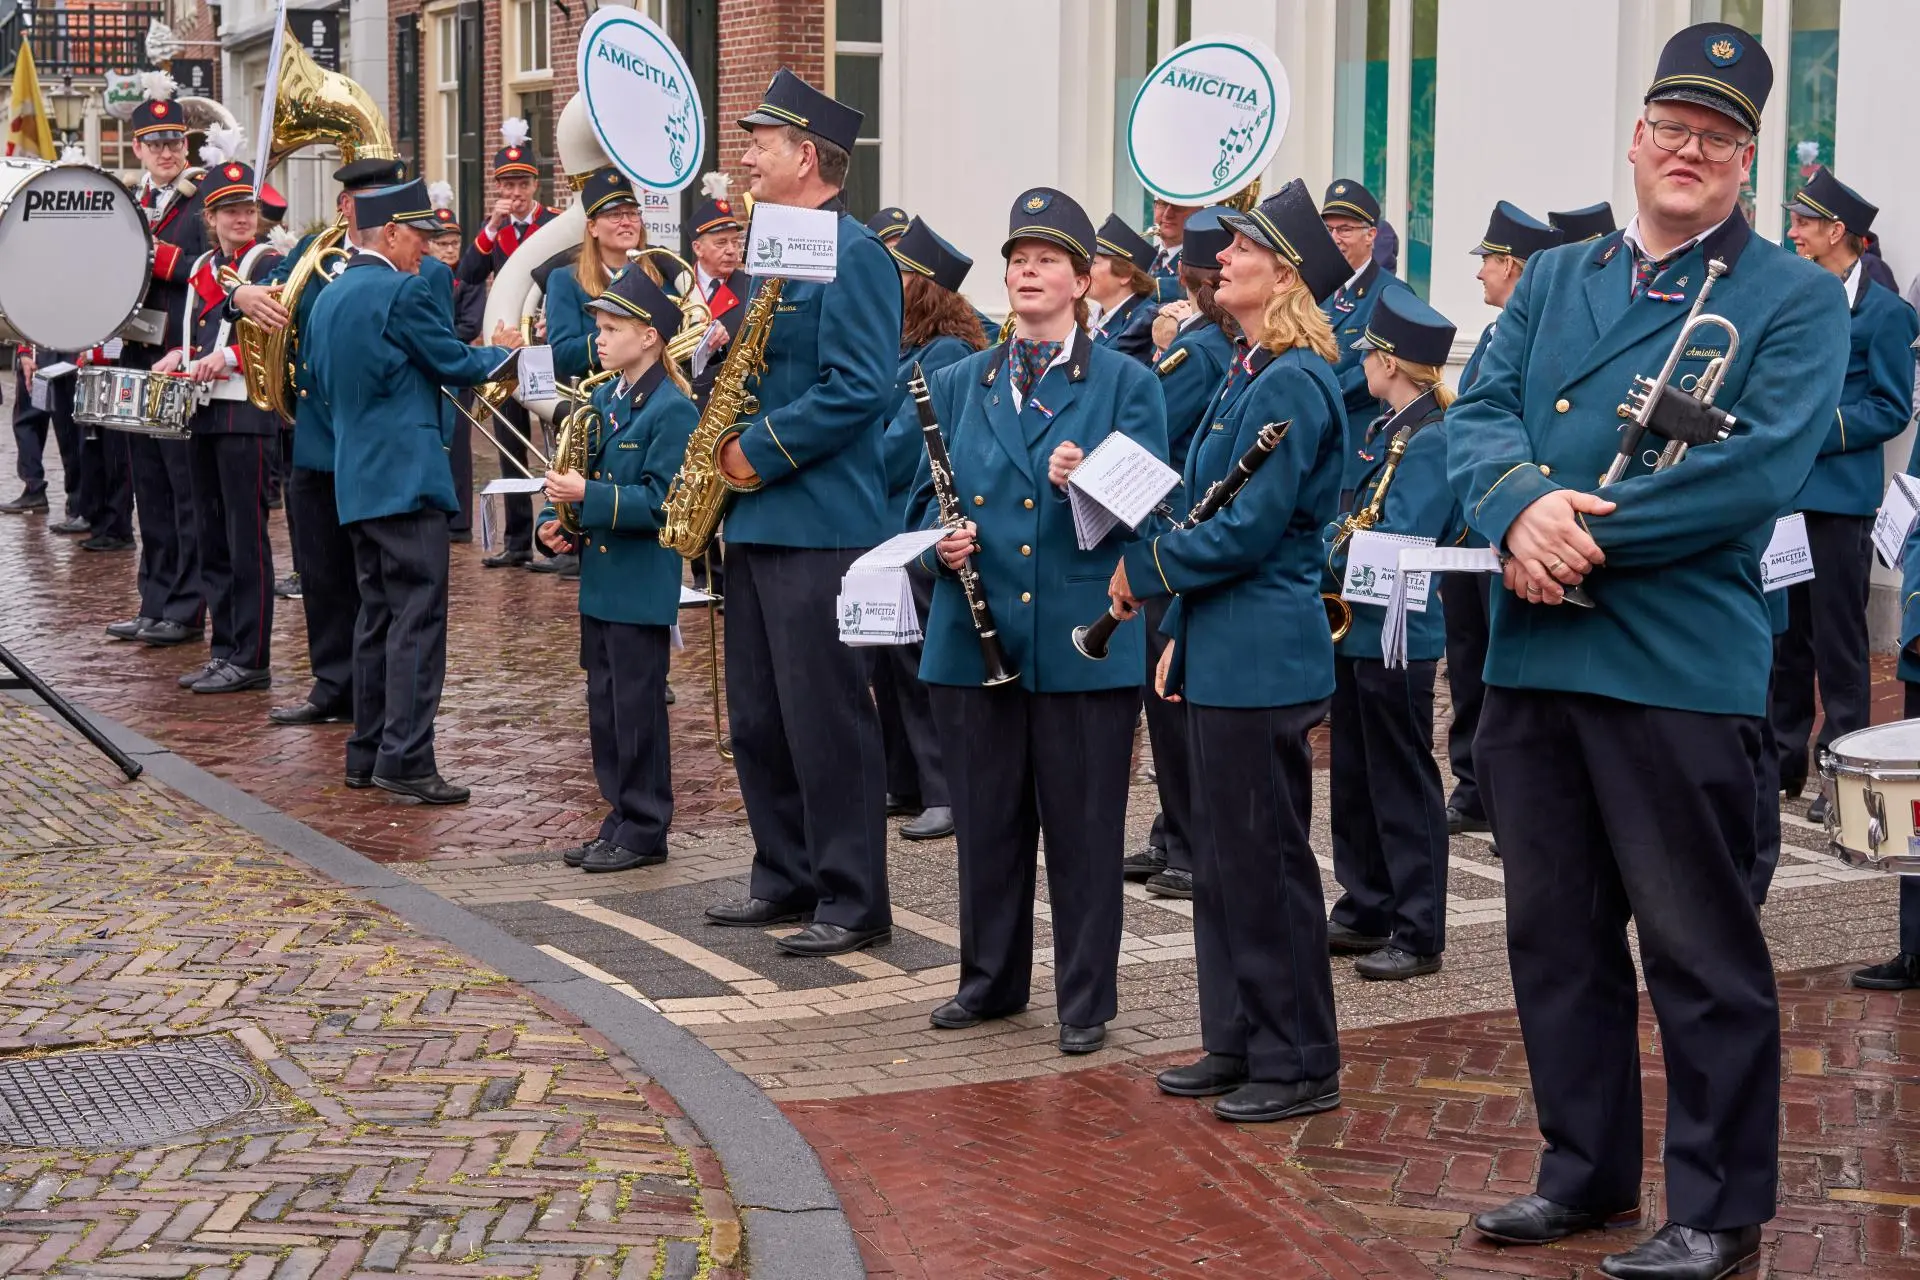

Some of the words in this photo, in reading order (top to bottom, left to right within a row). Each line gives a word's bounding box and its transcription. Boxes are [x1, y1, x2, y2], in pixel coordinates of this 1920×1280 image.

[597, 43, 680, 94] AMICITIA
[1160, 70, 1258, 106] AMICITIA
[644, 195, 669, 206] ERA
[788, 243, 833, 252] AMICITIA
[1771, 550, 1807, 565] AMICITIA
[865, 607, 895, 616] AMICITIA
